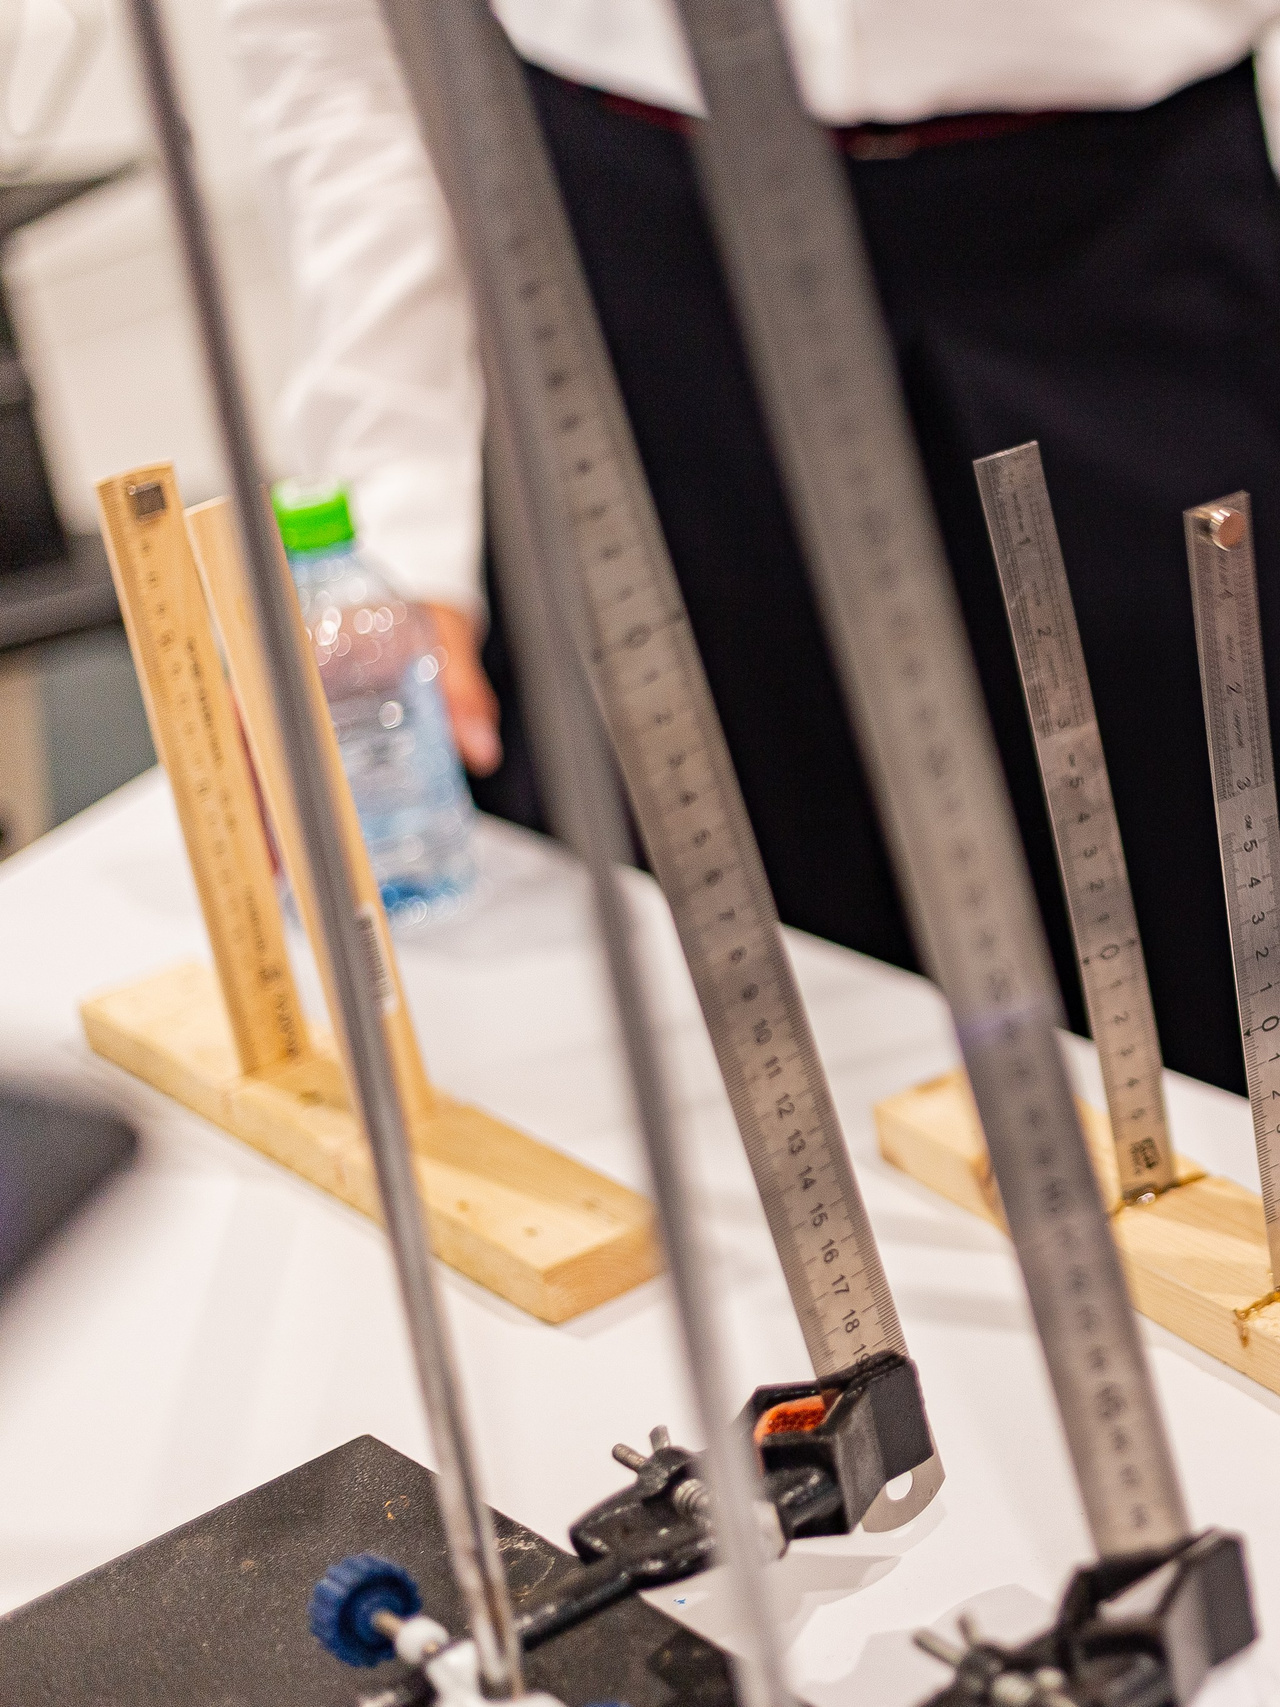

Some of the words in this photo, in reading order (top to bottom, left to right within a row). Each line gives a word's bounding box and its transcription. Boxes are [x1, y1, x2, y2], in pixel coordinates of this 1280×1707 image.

[1037, 626, 1052, 637] 2
[1057, 717, 1072, 729] 3
[1227, 681, 1242, 695] 2
[1237, 776, 1252, 791] 3
[1243, 839, 1259, 853] 5
[1247, 876, 1261, 888] 4
[1251, 911, 1266, 925] 3
[1099, 943, 1120, 960] 0
[1255, 946, 1269, 961] 2
[1259, 982, 1272, 992] 1
[1261, 1015, 1279, 1032] 0
[1268, 1052, 1280, 1062] 1
[764, 1056, 782, 1079] 11
[776, 1093, 796, 1119] 12
[787, 1129, 807, 1156] 13
[798, 1166, 817, 1192] 14
[808, 1203, 829, 1228] 15
[821, 1238, 840, 1264] 16
[831, 1273, 850, 1295] 17
[842, 1309, 861, 1333] 18
